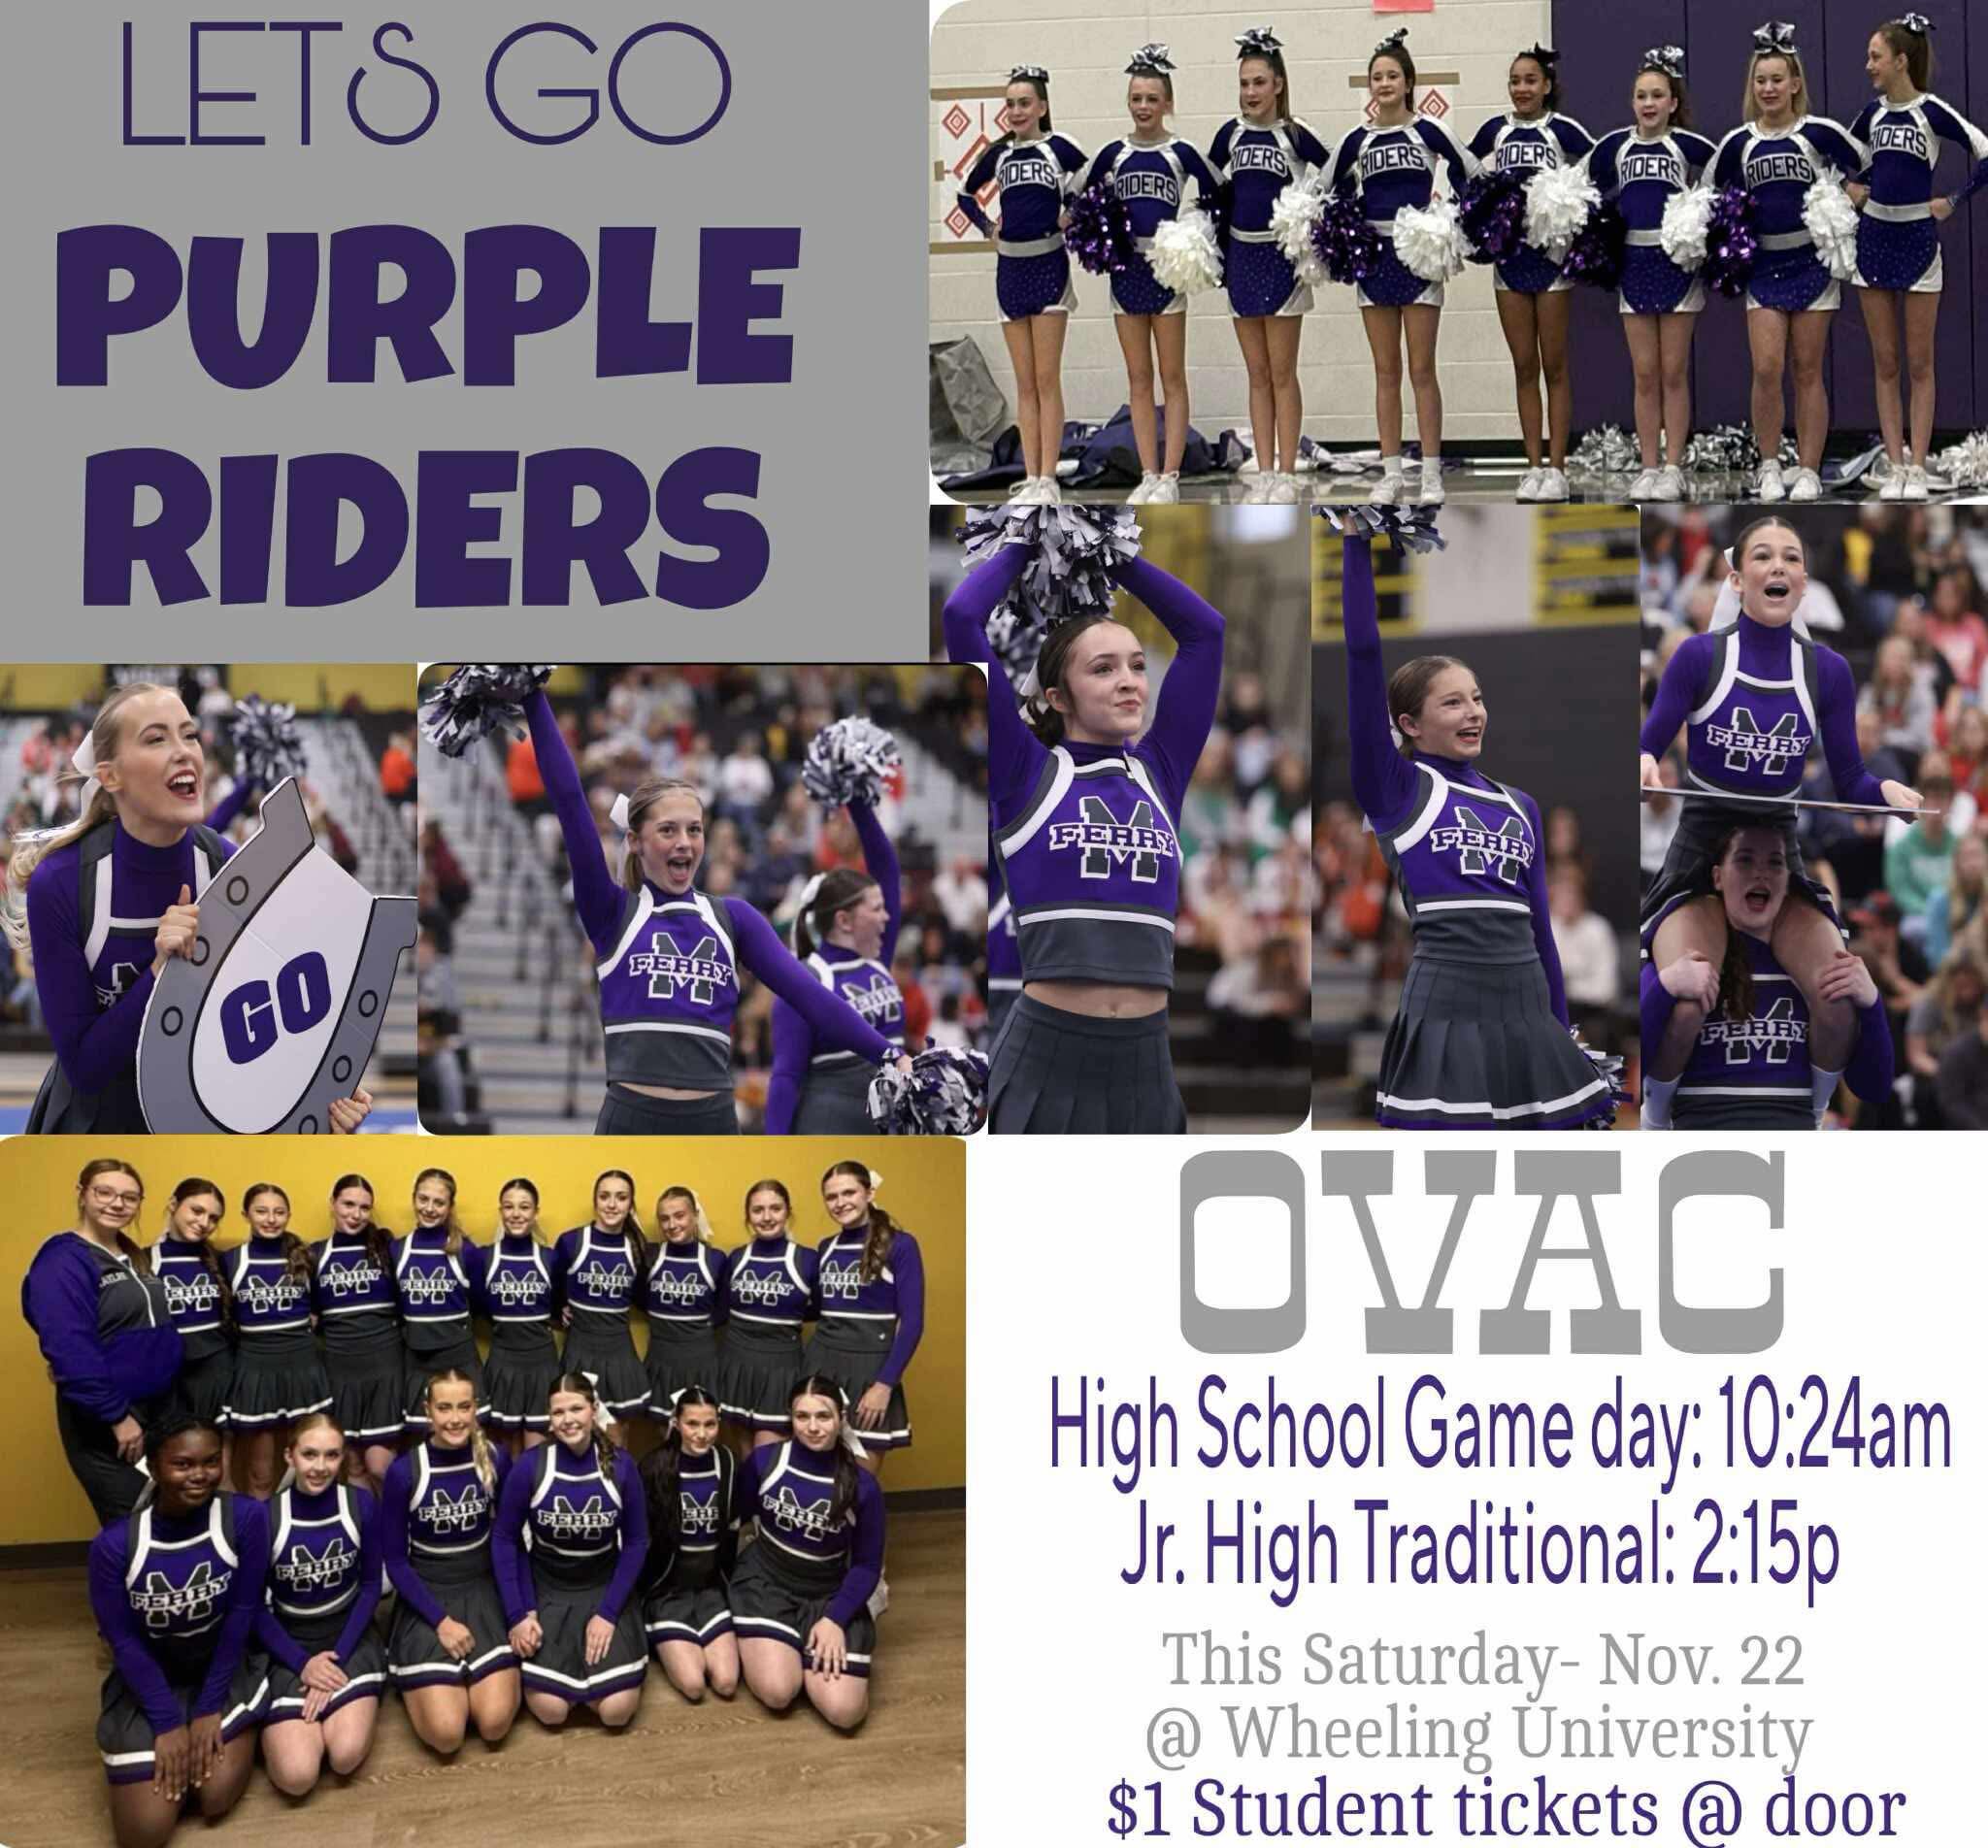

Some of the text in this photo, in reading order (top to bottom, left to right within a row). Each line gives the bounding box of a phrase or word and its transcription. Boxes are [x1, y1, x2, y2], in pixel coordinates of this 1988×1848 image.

[1362, 144, 1427, 180] RIDERS
[1495, 142, 1558, 171] RIDERS
[1620, 154, 1683, 188] RIDERS
[1747, 152, 1813, 186] RIDERS
[1116, 172, 1178, 206] RIDERS
[1706, 723, 1810, 757] FERRY
[1724, 707, 1798, 776] M
[1049, 822, 1174, 858] FERRY
[1079, 796, 1159, 883] M
[1454, 806, 1523, 885] M
[629, 953, 733, 986] FERRY
[648, 932, 717, 1006] M
[220, 951, 332, 1065] GO
[1701, 1020, 1807, 1045] FERRY
[237, 1286, 305, 1302] FERRY
[319, 1270, 381, 1287] FERRY
[400, 1279, 457, 1292] FERRY
[538, 1509, 617, 1527] FERRY
[276, 1550, 357, 1580] FERRY
[130, 1570, 232, 1611] FERRY
